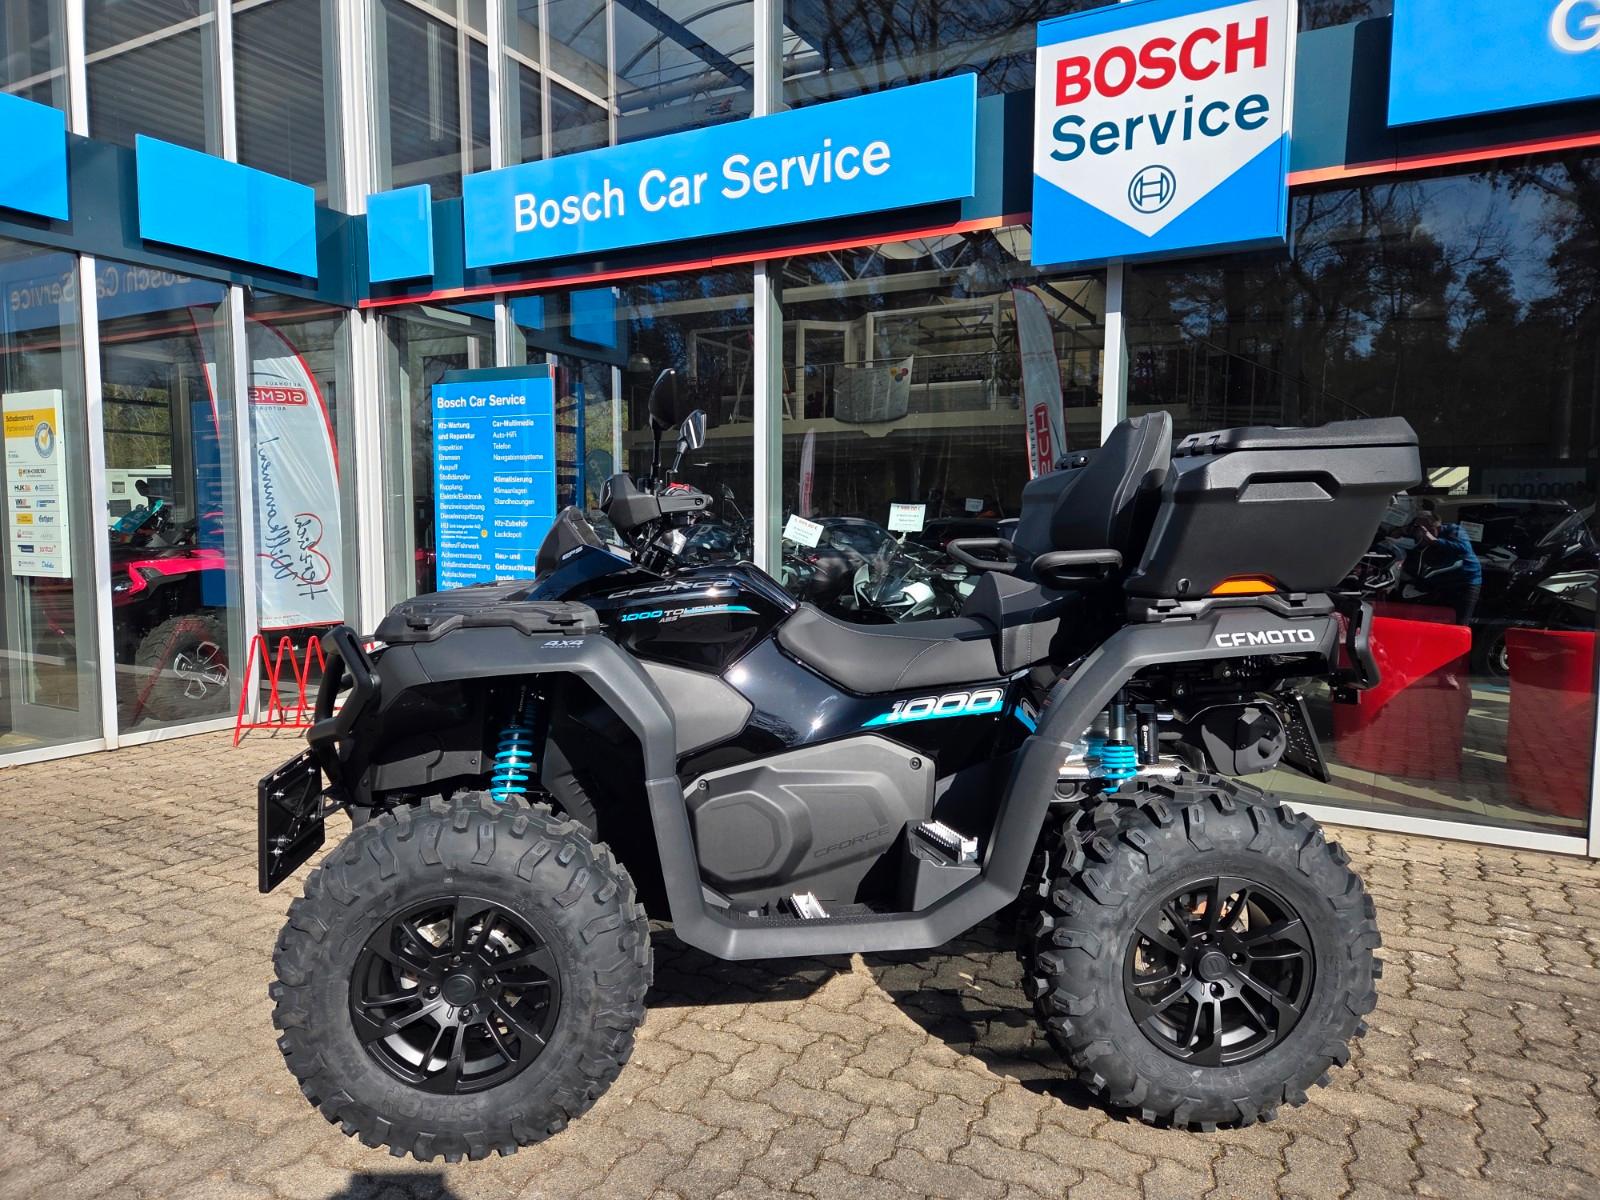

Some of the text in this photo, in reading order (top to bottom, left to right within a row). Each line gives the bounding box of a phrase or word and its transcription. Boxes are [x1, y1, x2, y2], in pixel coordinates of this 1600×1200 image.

[1055, 15, 1269, 107] BOSCH
[1049, 92, 1270, 162] Service
[513, 137, 892, 233] Bosch Car Service
[437, 394, 526, 408] Bosch Car Service
[620, 610, 663, 622] 1000
[1214, 629, 1316, 648] CFMOTO
[890, 687, 1004, 723] 1000
[814, 826, 890, 859] CFORCE
